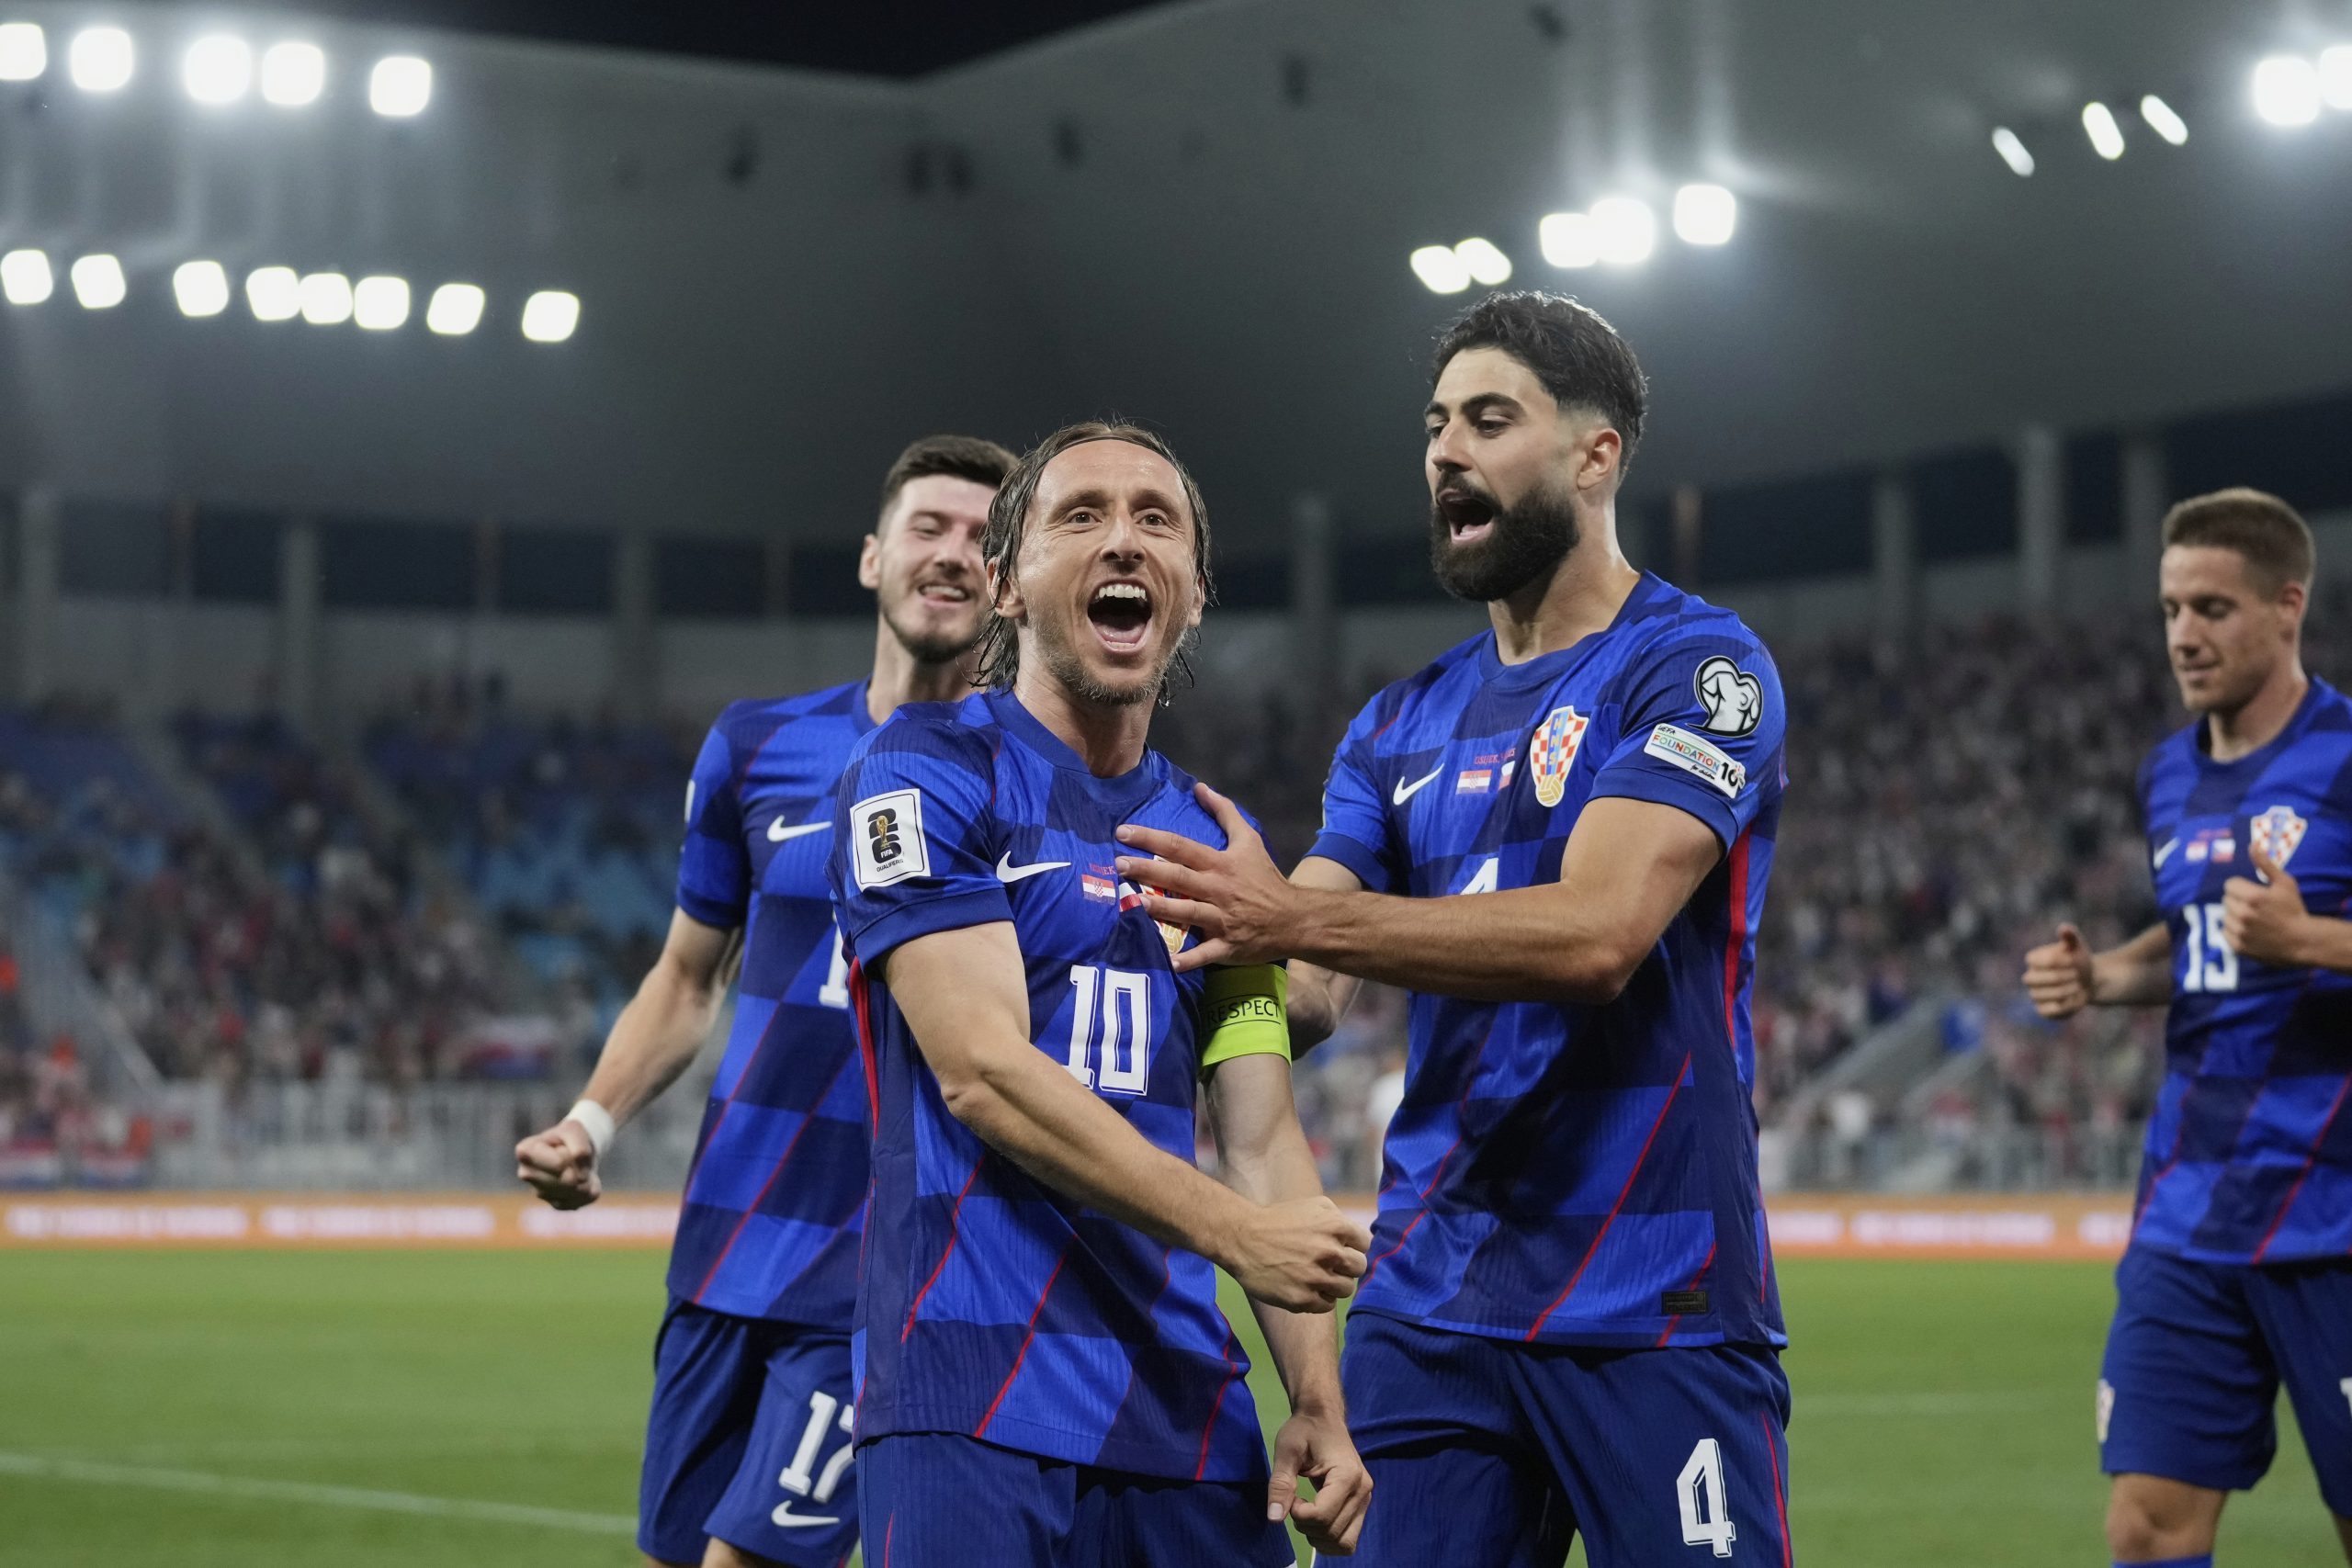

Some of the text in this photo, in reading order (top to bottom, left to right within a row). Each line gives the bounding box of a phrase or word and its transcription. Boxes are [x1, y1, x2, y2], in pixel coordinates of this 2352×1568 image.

[1652, 734, 1720, 772] FOUNDATION
[1657, 726, 1676, 735] UEFA
[880, 848, 894, 859] FIFA
[2183, 902, 2238, 992] 15
[1061, 964, 1151, 1096] 10
[778, 1391, 855, 1504] 17
[1676, 1438, 1736, 1558] 4
